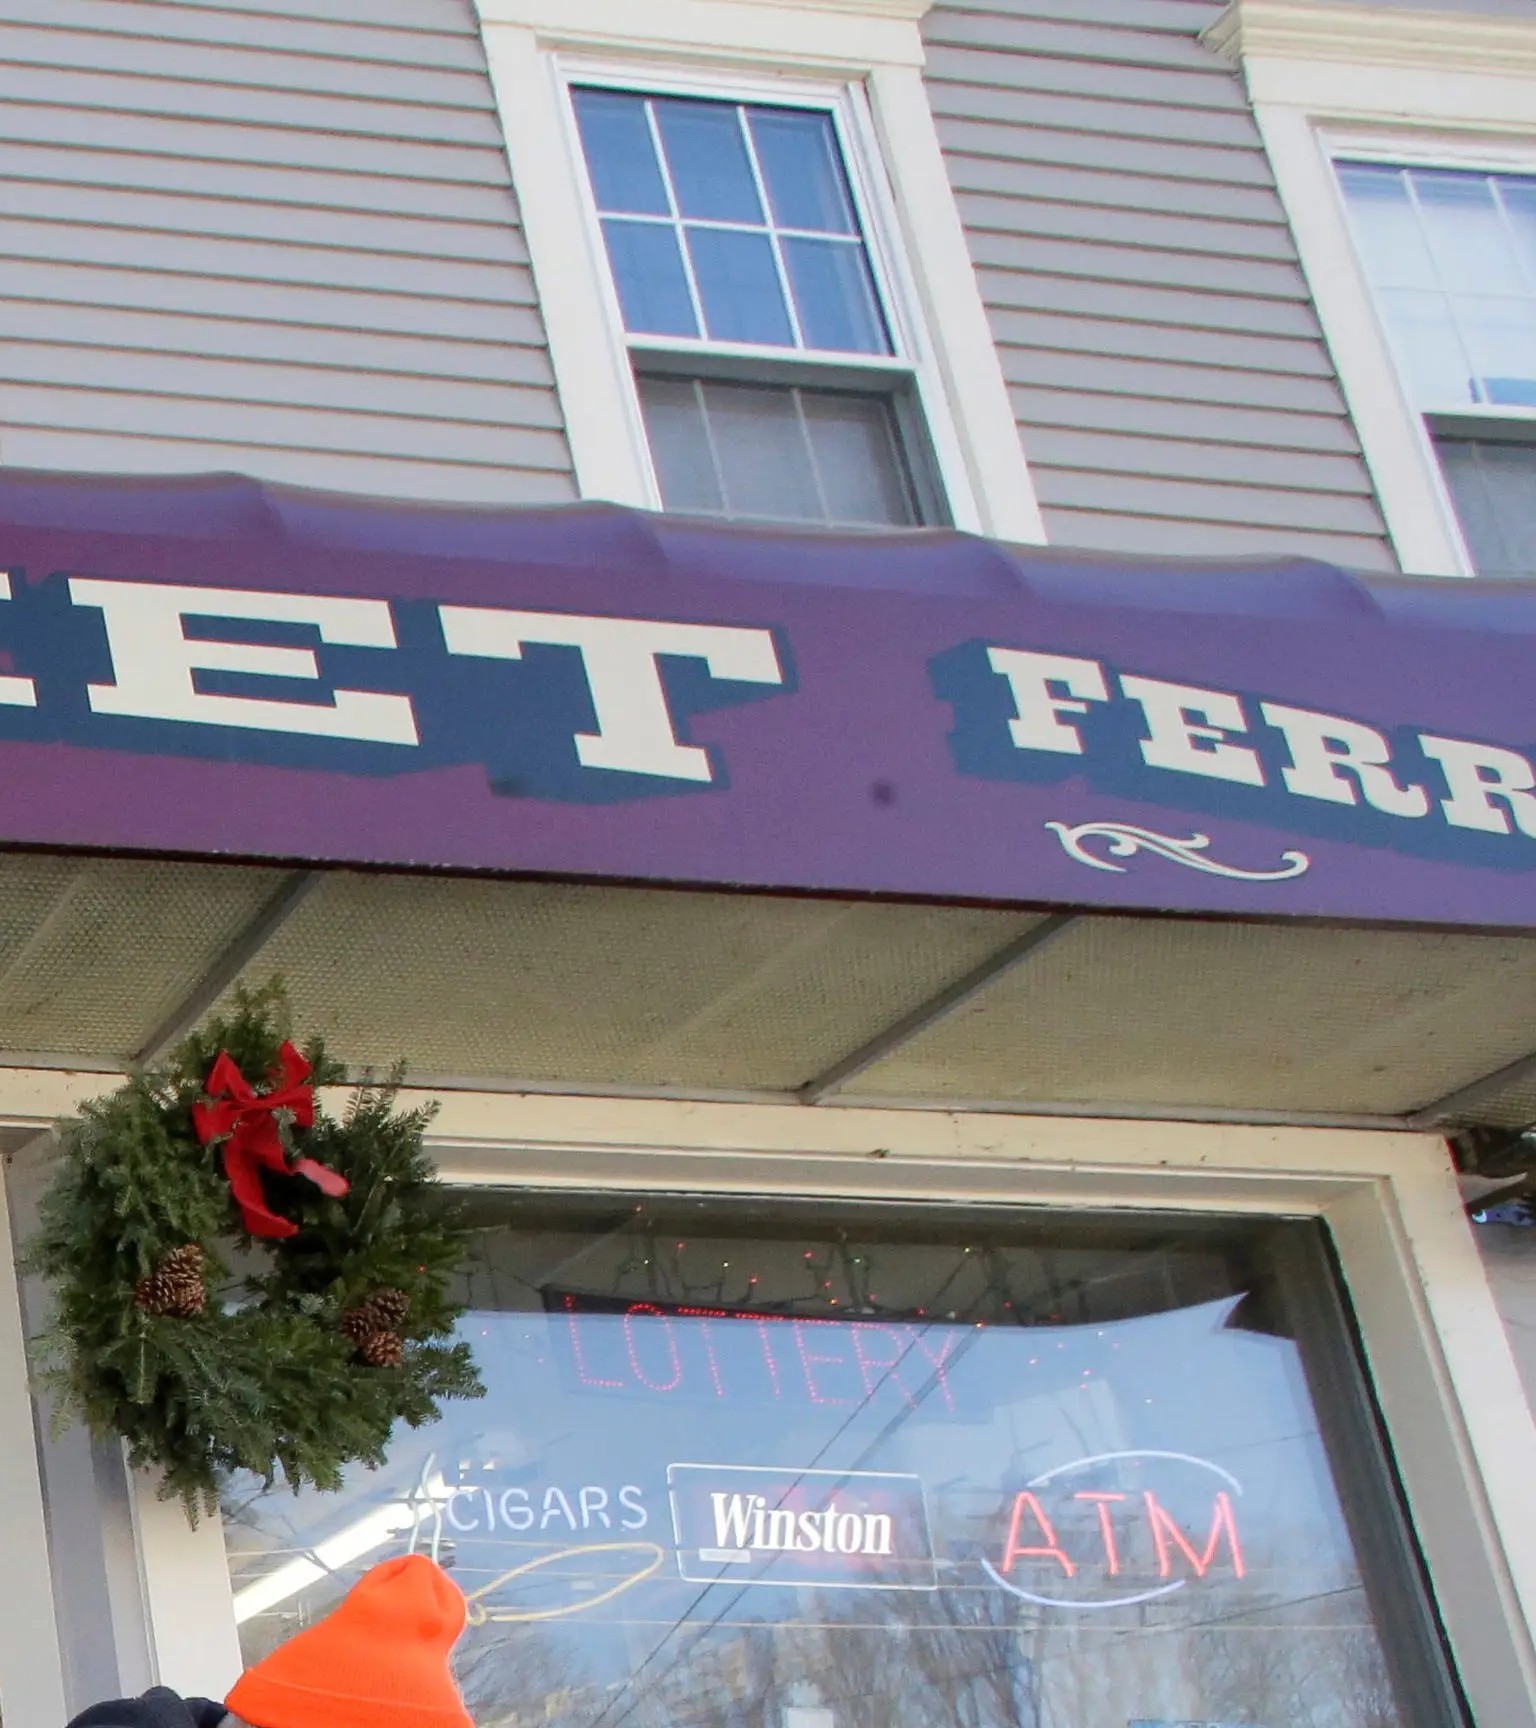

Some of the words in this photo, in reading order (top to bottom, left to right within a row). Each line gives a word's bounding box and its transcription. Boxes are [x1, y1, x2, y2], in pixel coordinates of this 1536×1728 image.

[564, 1292, 956, 1413] LOTTERY
[445, 1484, 649, 1532] CIGARS
[710, 1491, 894, 1555] Winston
[1001, 1490, 1246, 1579] ATM
